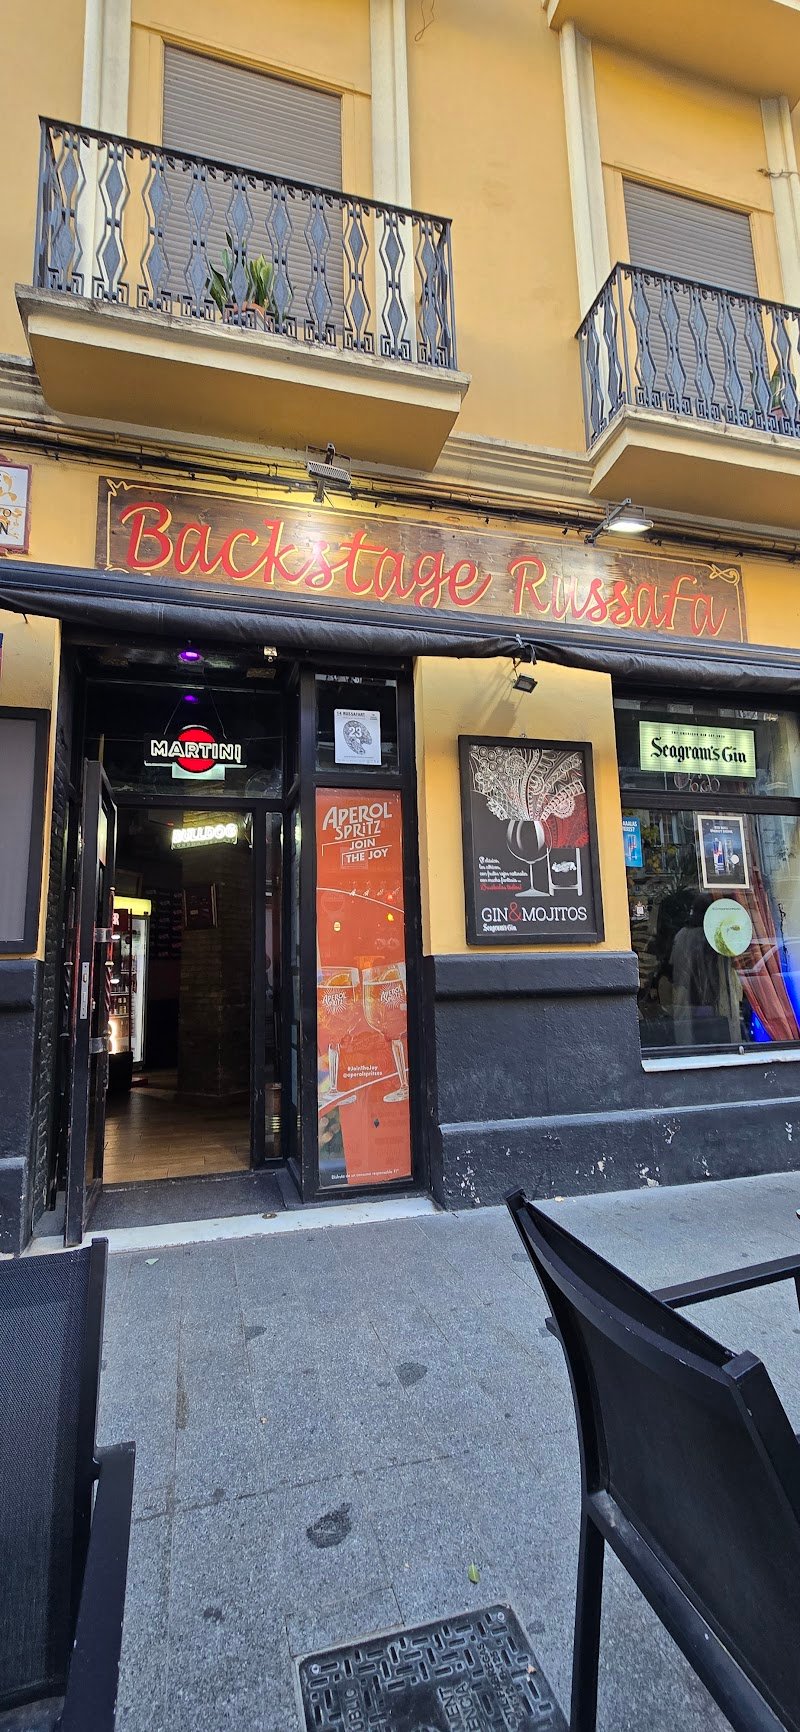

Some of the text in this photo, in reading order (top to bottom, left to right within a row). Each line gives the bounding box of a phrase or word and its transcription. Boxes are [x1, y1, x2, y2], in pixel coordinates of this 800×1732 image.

[119, 501, 728, 637] Backstage Russafa
[348, 726, 363, 738] 23
[150, 739, 242, 764] MARTINI
[650, 736, 747, 764] Seagram's Gin
[322, 802, 393, 831] APEROL
[172, 823, 238, 844] BULLDOG
[349, 838, 376, 851] JOIN
[346, 848, 389, 863] THE JOY
